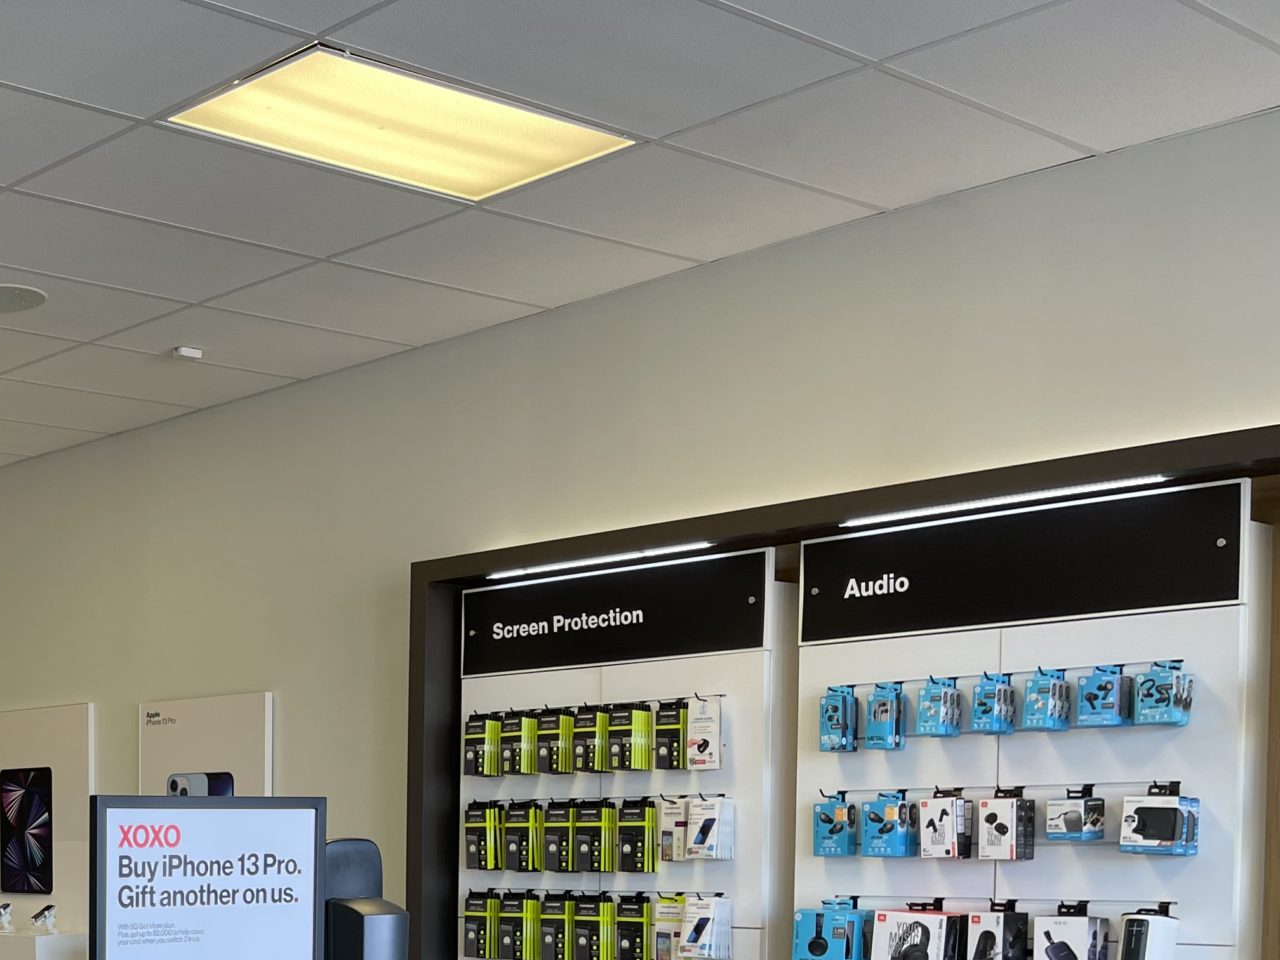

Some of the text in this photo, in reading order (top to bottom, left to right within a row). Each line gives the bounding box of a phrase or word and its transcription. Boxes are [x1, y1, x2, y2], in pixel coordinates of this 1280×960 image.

[843, 573, 909, 599] Audio
[492, 607, 643, 640] Screen Protection
[146, 711, 160, 720] Apple
[146, 719, 161, 727] iPhone
[118, 825, 181, 848] XOXO
[118, 853, 302, 882] Buy iPhone 13 Pro.
[118, 883, 299, 908] Gift another on us.
[889, 932, 920, 945] MUSIC
[896, 921, 919, 933] YOUR
